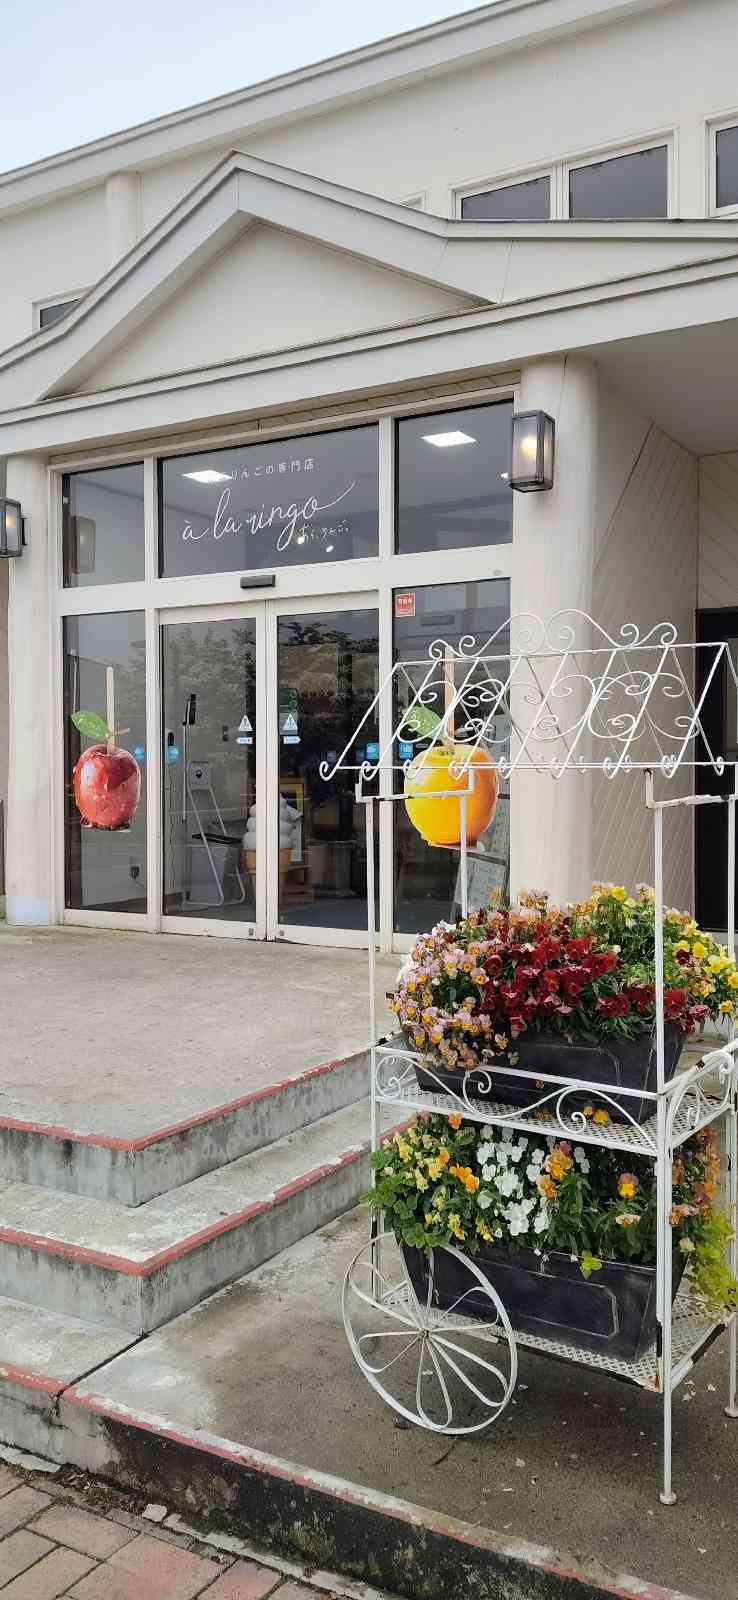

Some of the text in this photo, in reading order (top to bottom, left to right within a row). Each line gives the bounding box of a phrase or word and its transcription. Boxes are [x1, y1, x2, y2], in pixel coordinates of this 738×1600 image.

[182, 480, 357, 552] à la ringo
